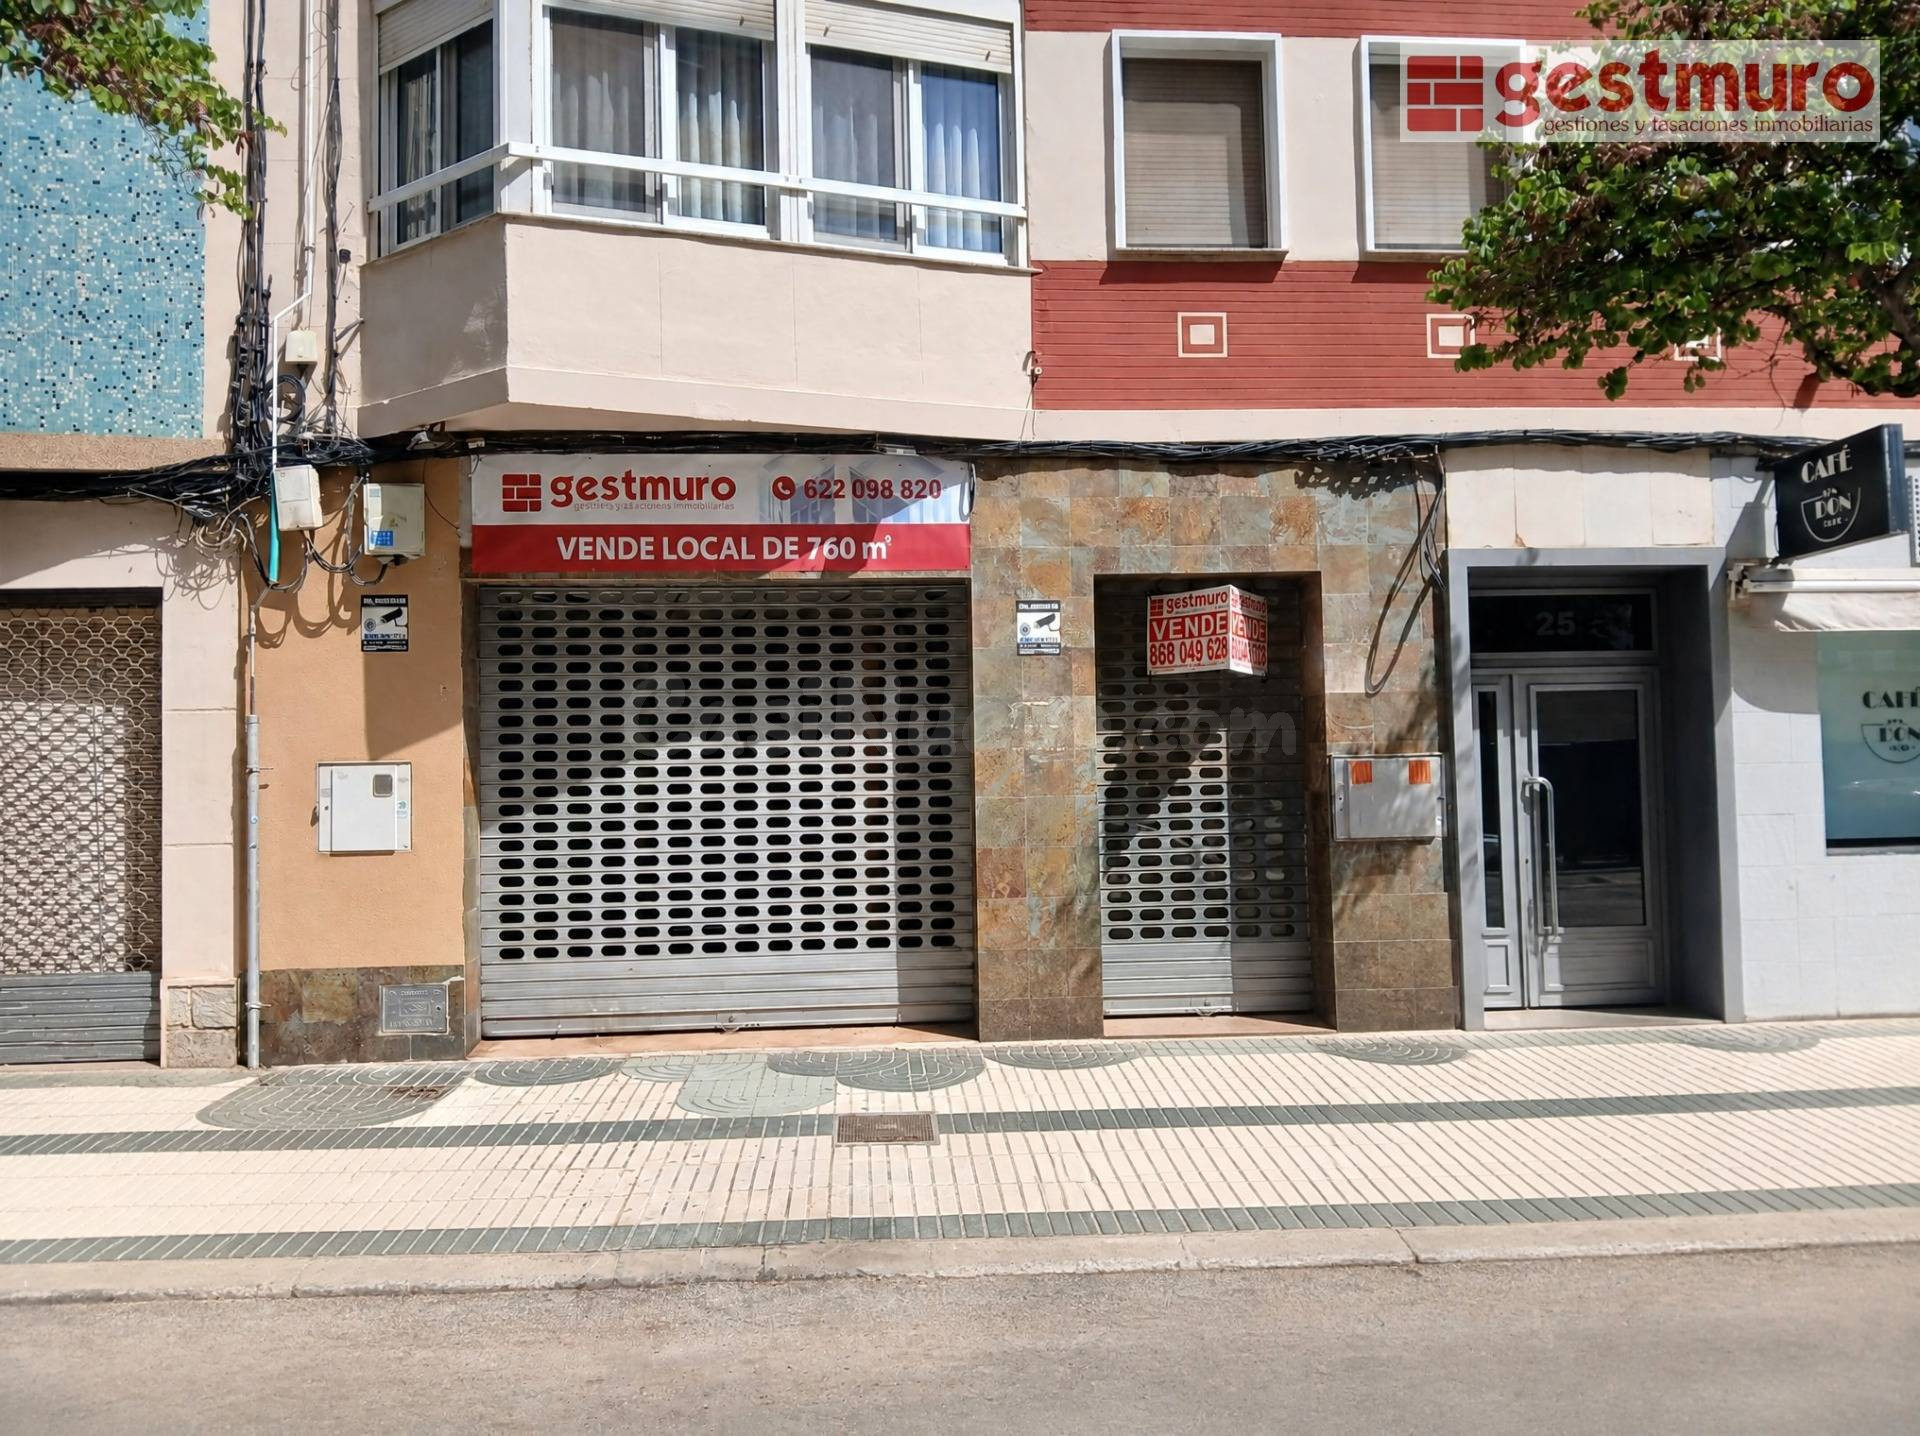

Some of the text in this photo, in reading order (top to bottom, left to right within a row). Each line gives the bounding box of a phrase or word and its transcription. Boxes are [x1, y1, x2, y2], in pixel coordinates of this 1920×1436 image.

[1801, 444, 1853, 484] CAFÉ
[550, 470, 737, 507] gestmuro
[804, 477, 942, 500] 622 098 820
[1815, 493, 1852, 519] DON
[557, 537, 653, 561] VENDE
[663, 536, 757, 561] LOCAL
[763, 536, 798, 560] DE
[807, 536, 856, 560] 760
[1166, 590, 1228, 615] gestmuro
[1151, 613, 1228, 641] VENDE
[1536, 611, 1577, 637] 25
[1150, 642, 1175, 666] 868
[1180, 639, 1203, 663] 049
[1206, 636, 1228, 660] 628
